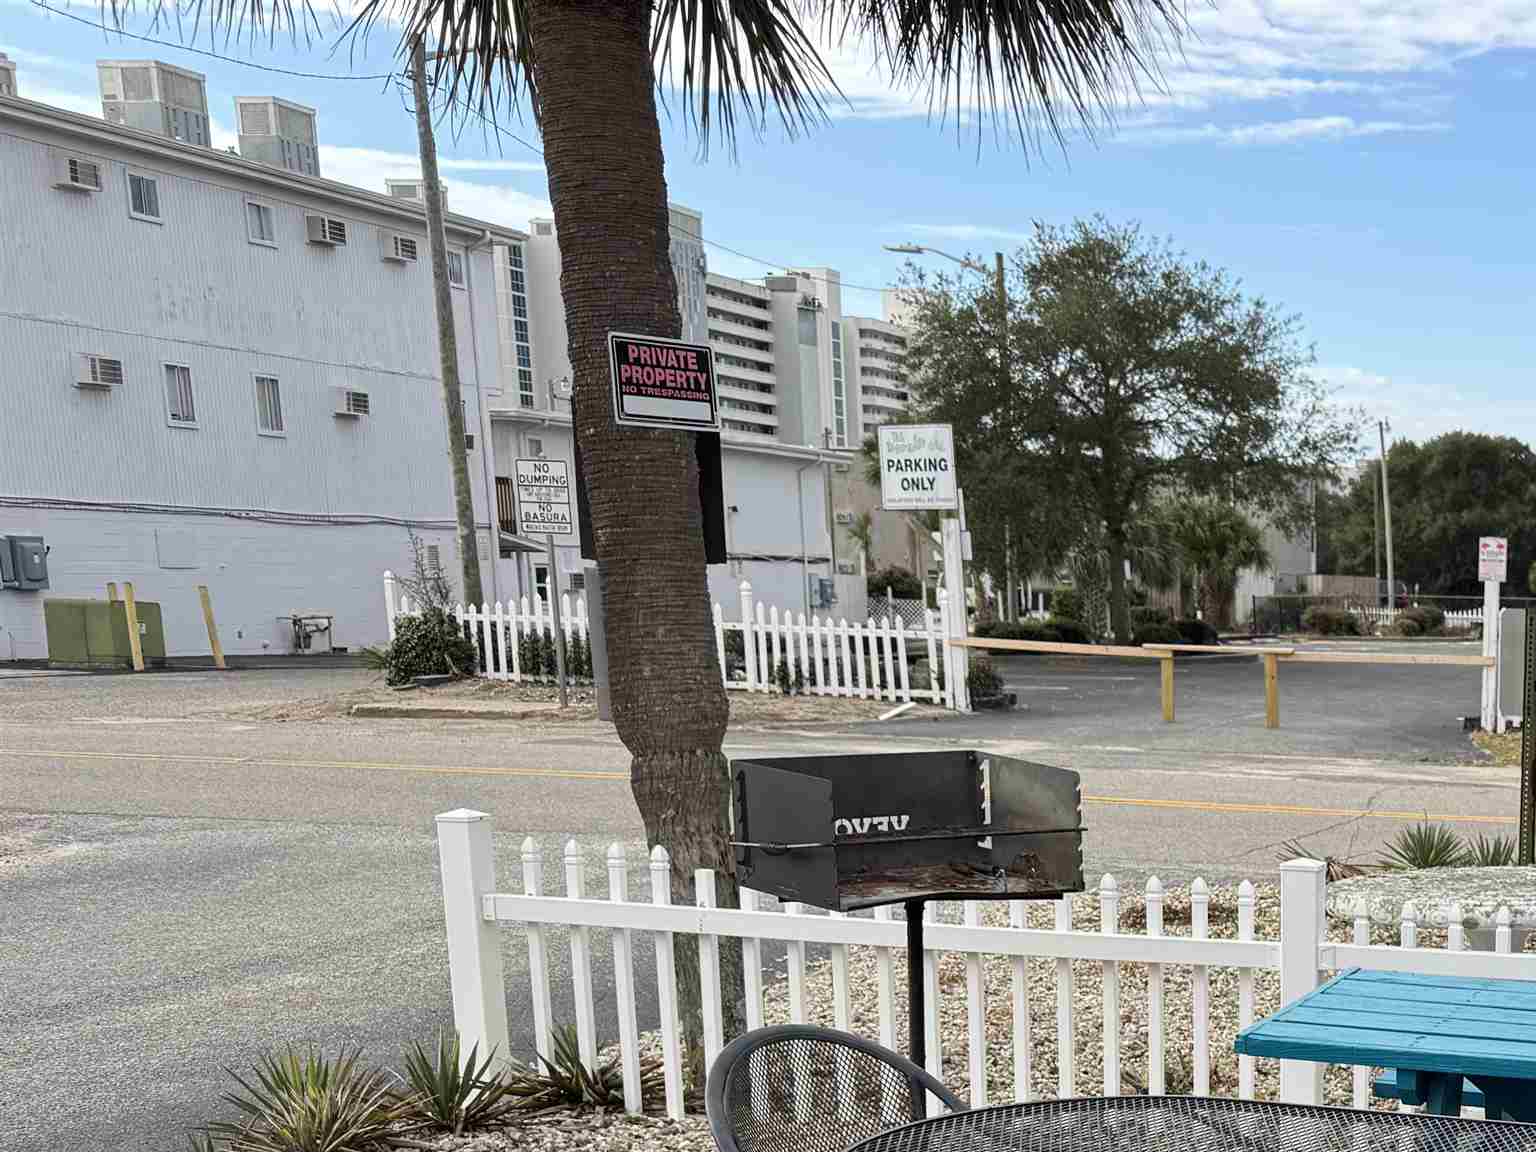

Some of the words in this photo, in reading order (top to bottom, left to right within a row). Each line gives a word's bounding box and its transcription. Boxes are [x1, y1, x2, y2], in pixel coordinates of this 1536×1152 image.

[628, 344, 697, 369] PRIVATE
[621, 364, 707, 391] PROPERTY
[622, 384, 637, 393] NO
[641, 386, 710, 401] TRESPASSING
[534, 464, 549, 473] NO
[887, 458, 948, 472] PARKING
[519, 474, 567, 486] DUMPING
[901, 477, 935, 491] ONLY
[538, 503, 553, 513] NO
[524, 511, 568, 522] BASURA
